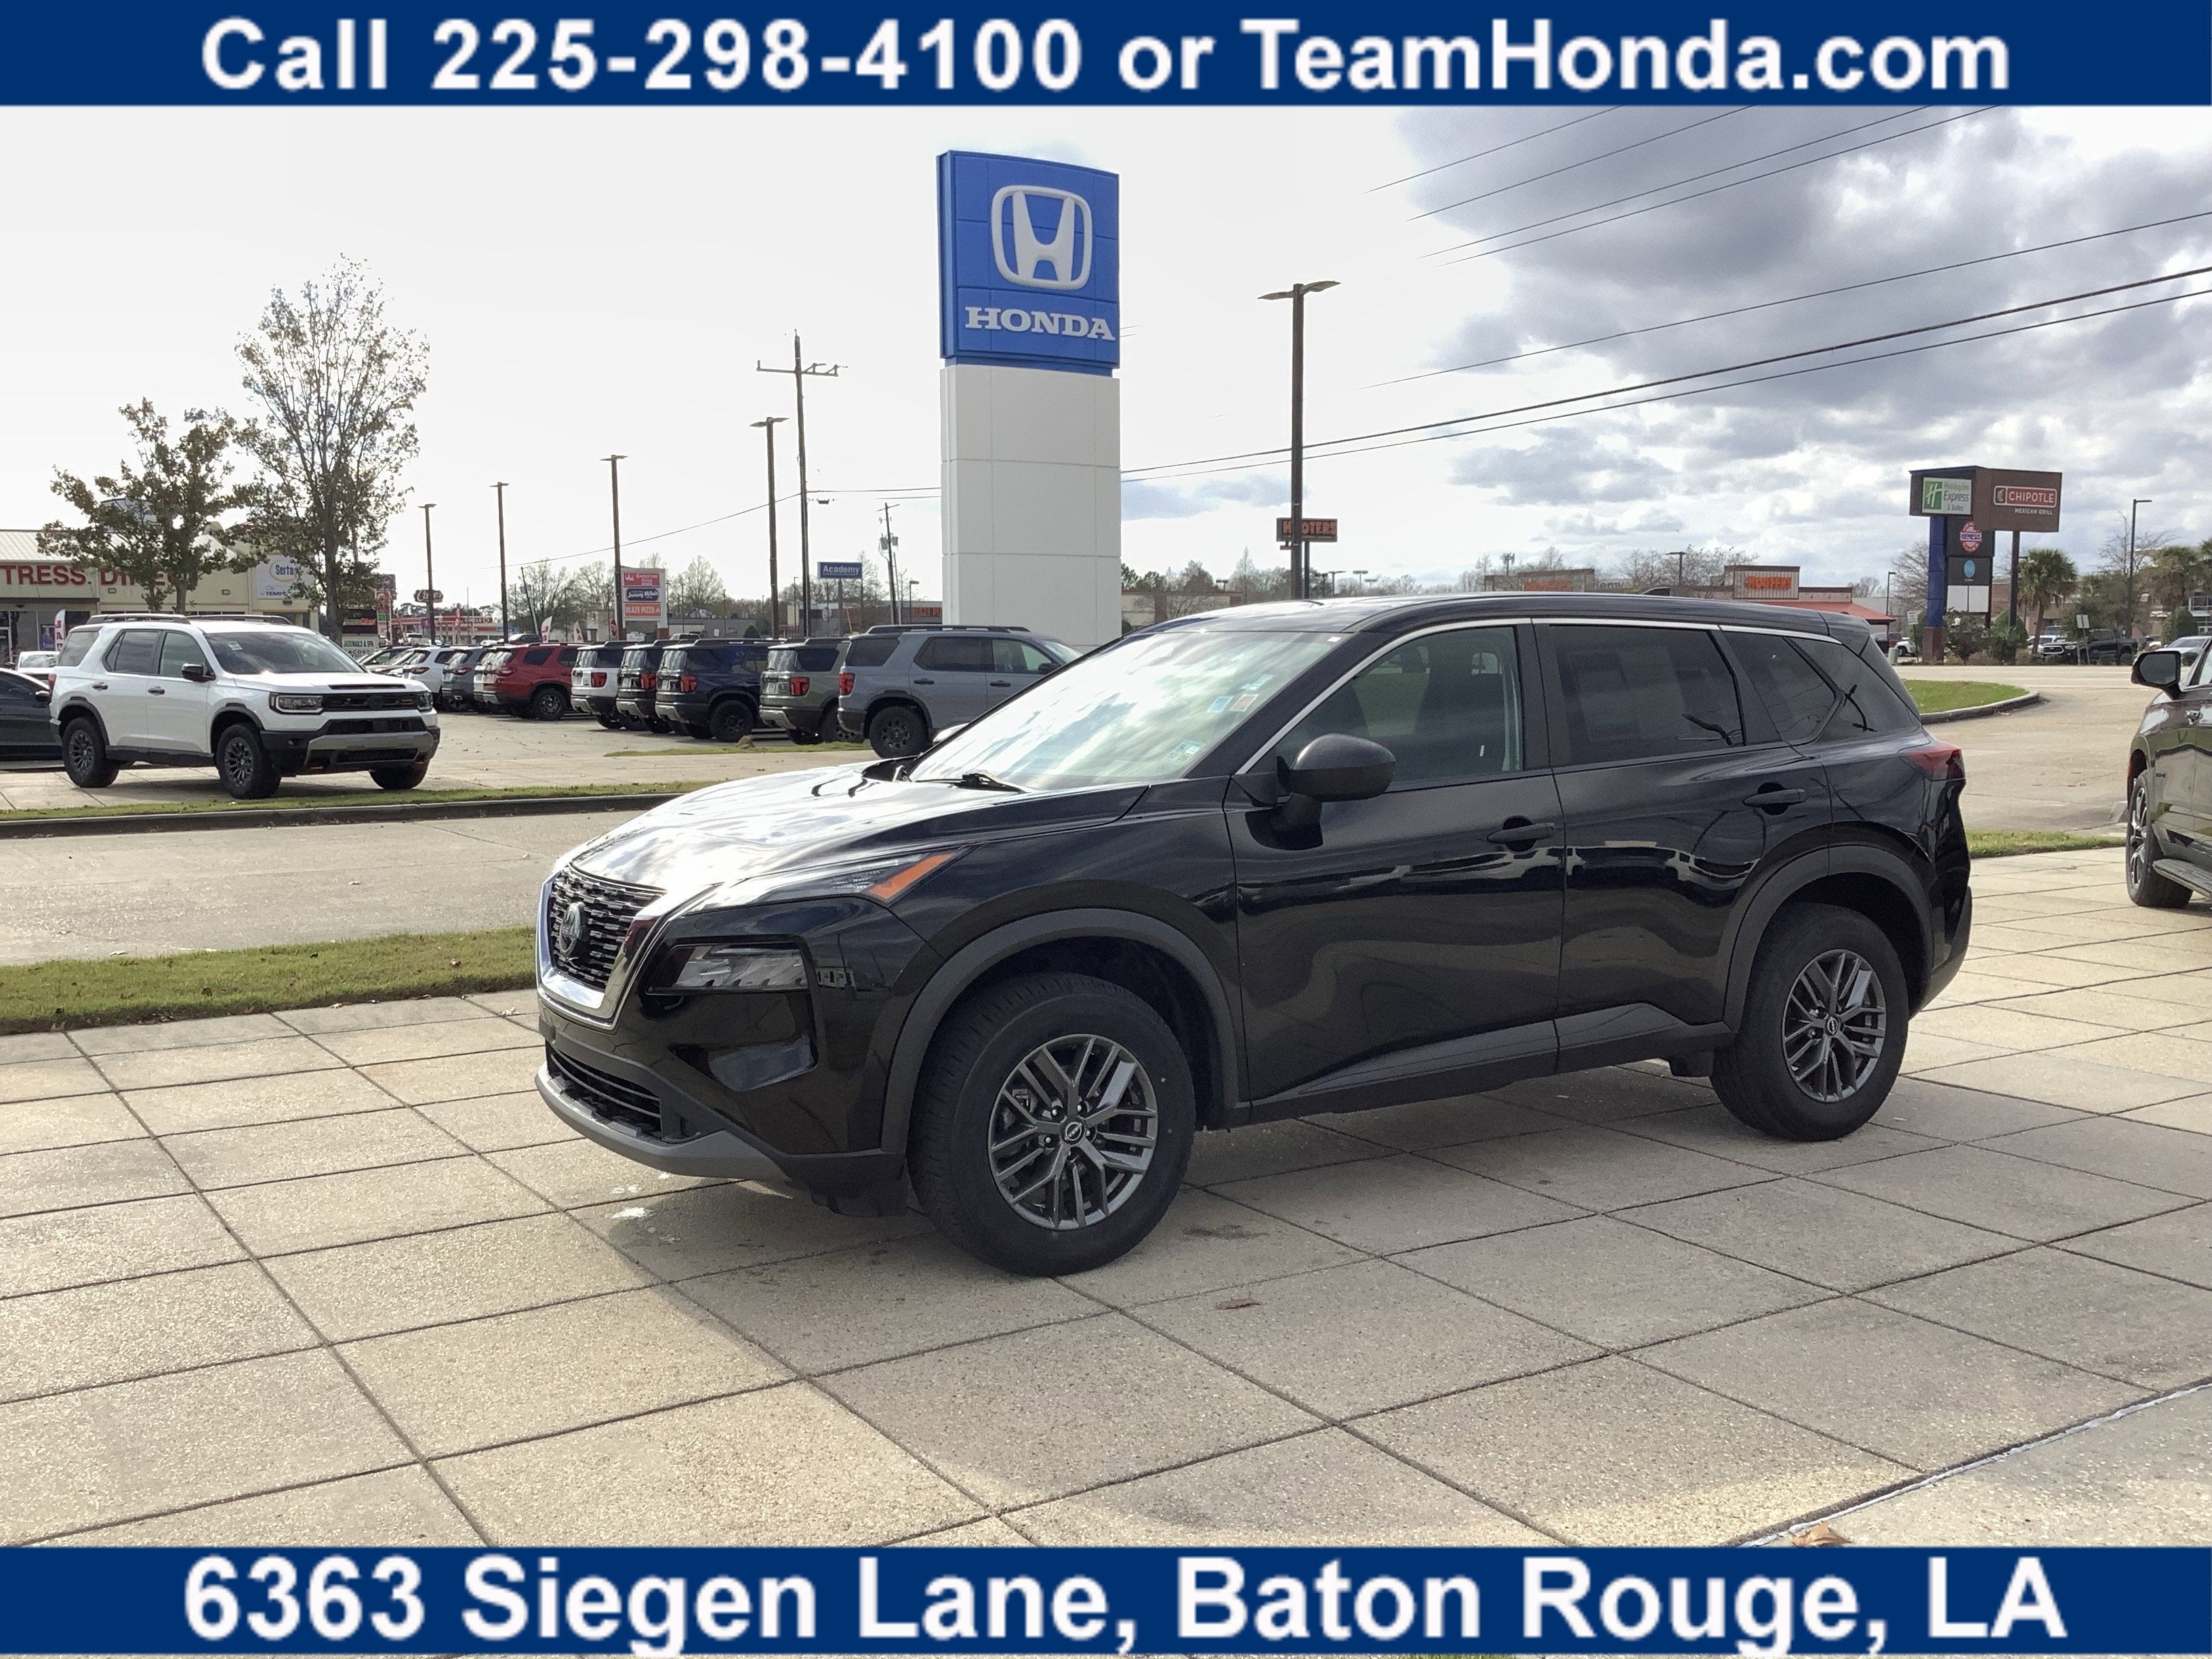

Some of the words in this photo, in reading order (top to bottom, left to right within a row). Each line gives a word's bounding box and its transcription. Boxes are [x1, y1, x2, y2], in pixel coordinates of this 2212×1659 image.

[965, 306, 1115, 341] HONDA
[1944, 490, 1969, 503] Express
[2009, 491, 2054, 503] CHIPOTLE
[1282, 520, 1336, 535] HOTERS
[275, 565, 294, 575] Serta
[823, 565, 860, 575] Academy
